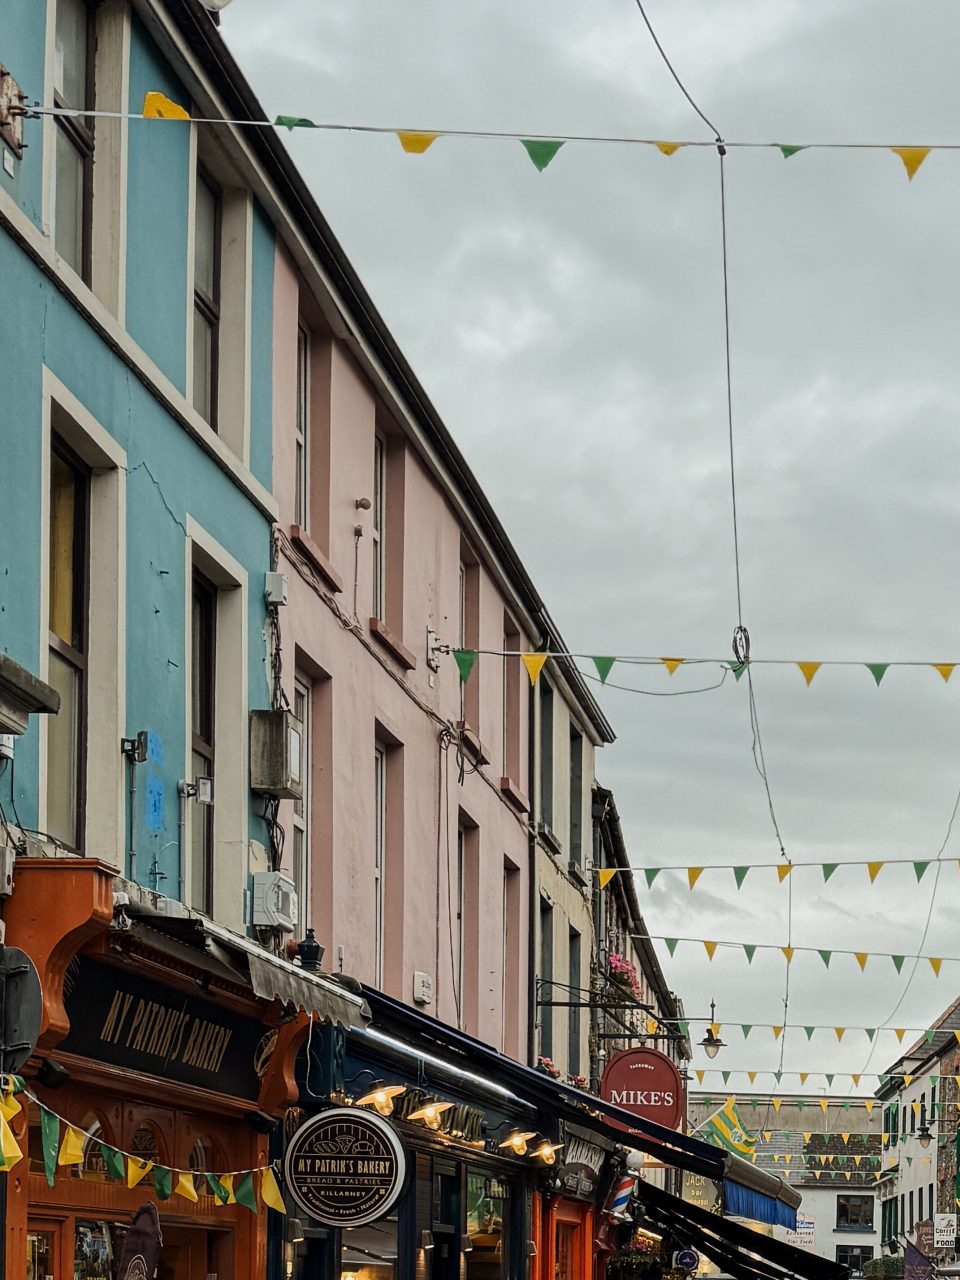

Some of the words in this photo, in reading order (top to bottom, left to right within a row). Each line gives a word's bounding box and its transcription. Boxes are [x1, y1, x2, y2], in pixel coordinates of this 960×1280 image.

[100, 990, 134, 1044] MY
[126, 998, 190, 1060] PATRIK'S
[181, 1017, 233, 1073] BAKERY
[610, 1090, 674, 1106] MIKE'S
[298, 1158, 313, 1173] MY
[315, 1159, 354, 1174] PATRIK'S
[357, 1160, 391, 1175] BAKERY
[307, 1193, 335, 1213] Traditional
[360, 1194, 380, 1211] Natural
